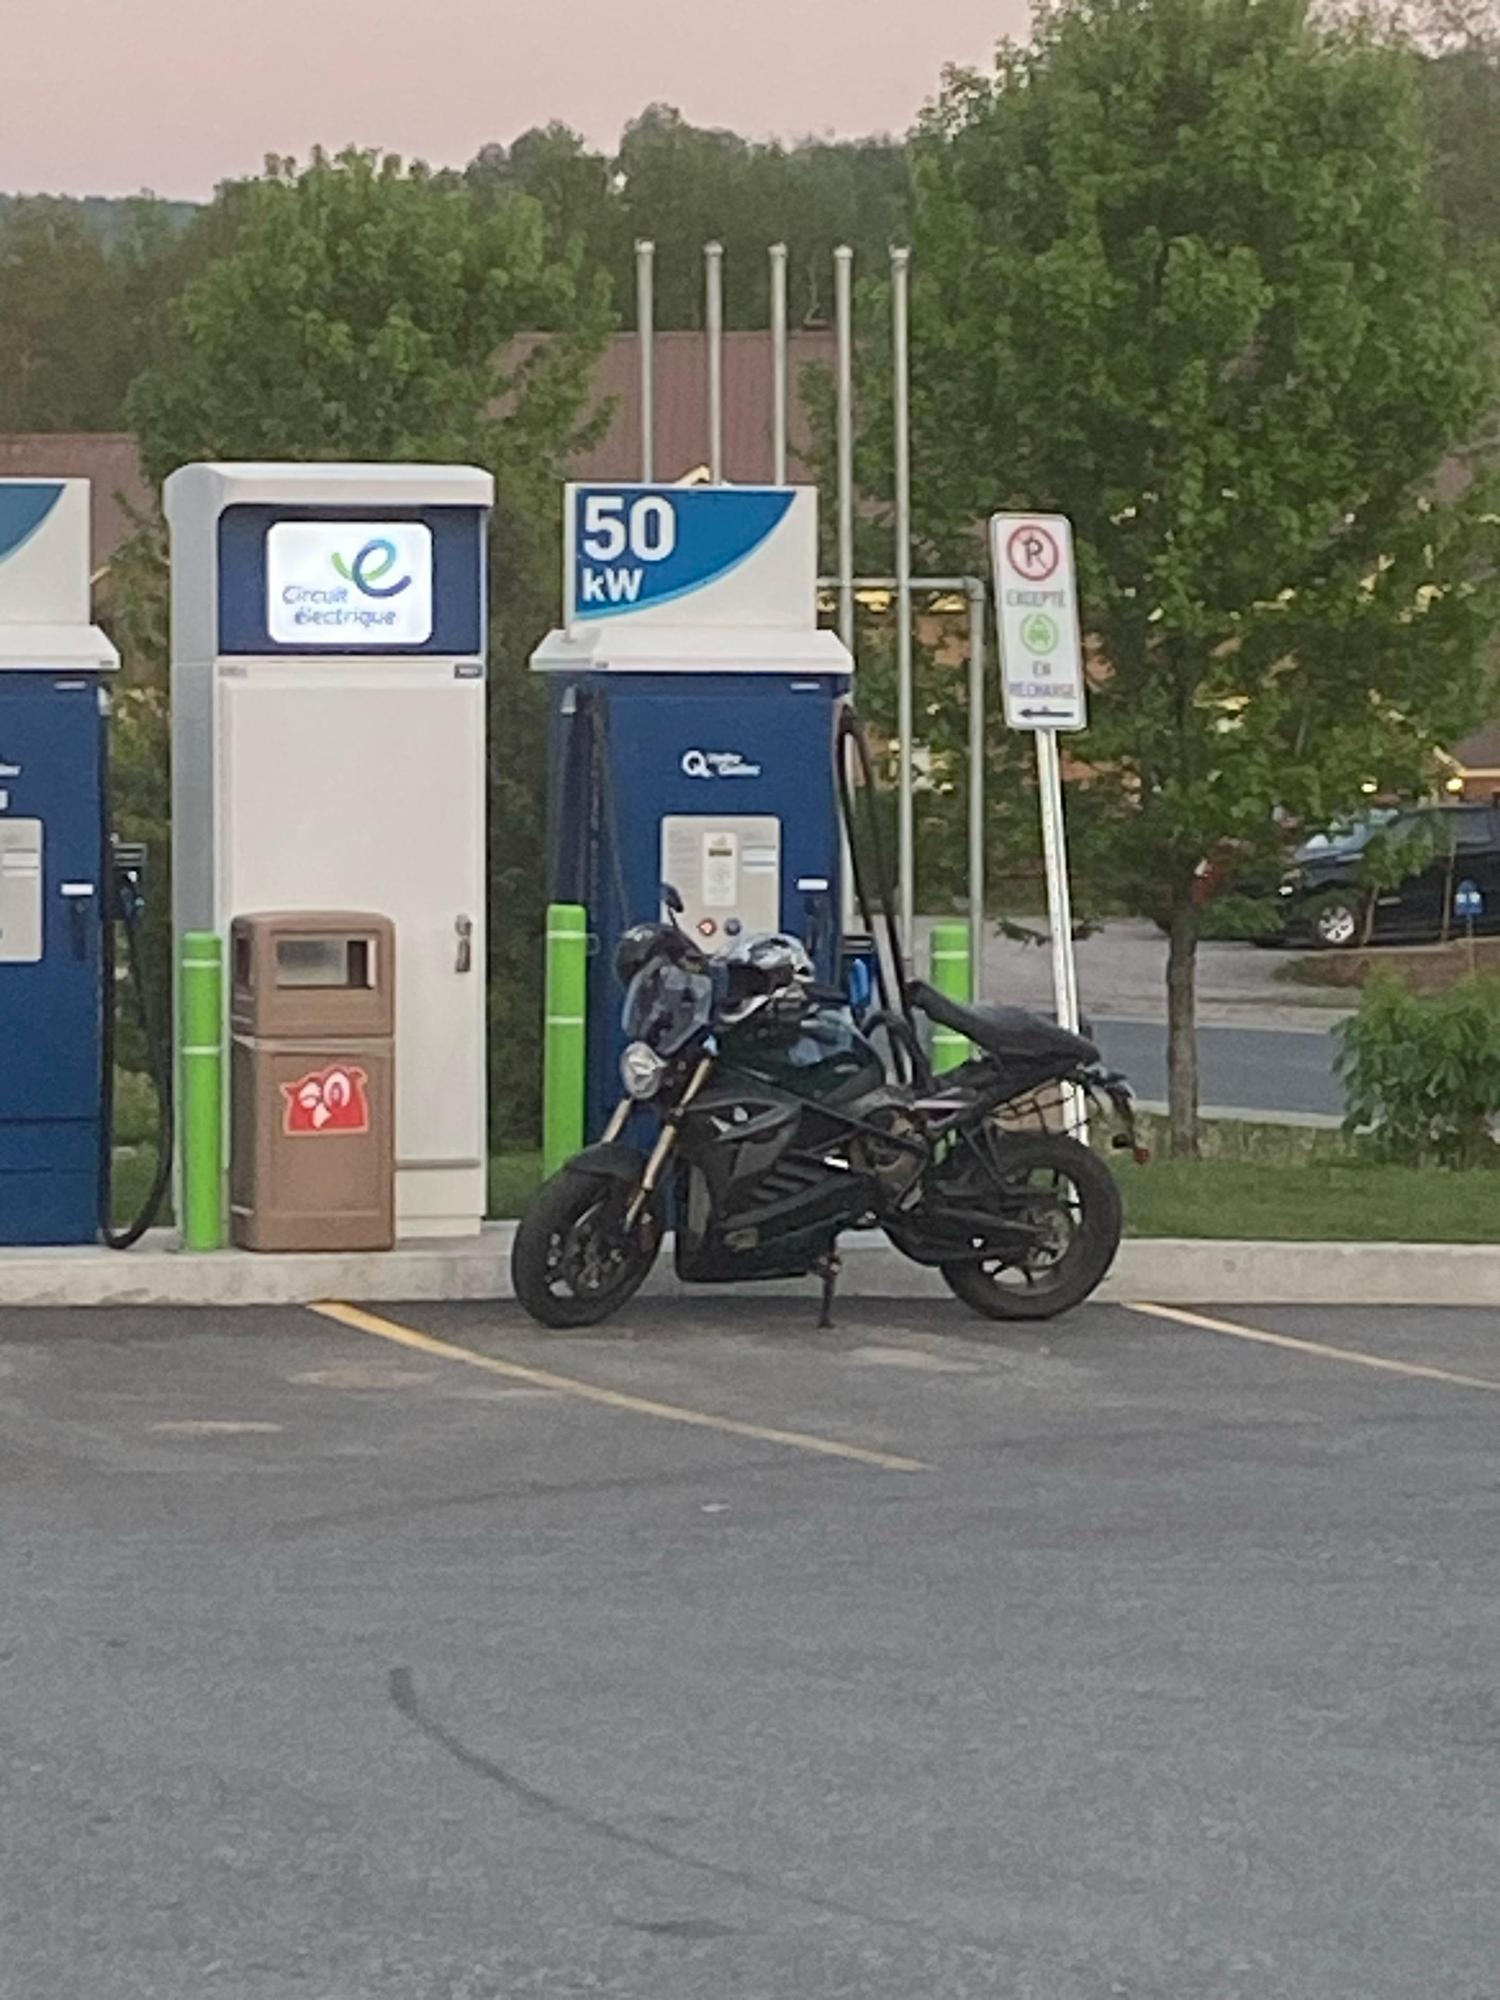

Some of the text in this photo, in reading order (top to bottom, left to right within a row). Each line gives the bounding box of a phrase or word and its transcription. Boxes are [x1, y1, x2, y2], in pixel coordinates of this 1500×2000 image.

[583, 496, 676, 561] 50
[282, 585, 348, 604] Circuit
[582, 568, 643, 602] kW
[294, 607, 396, 627] électrique
